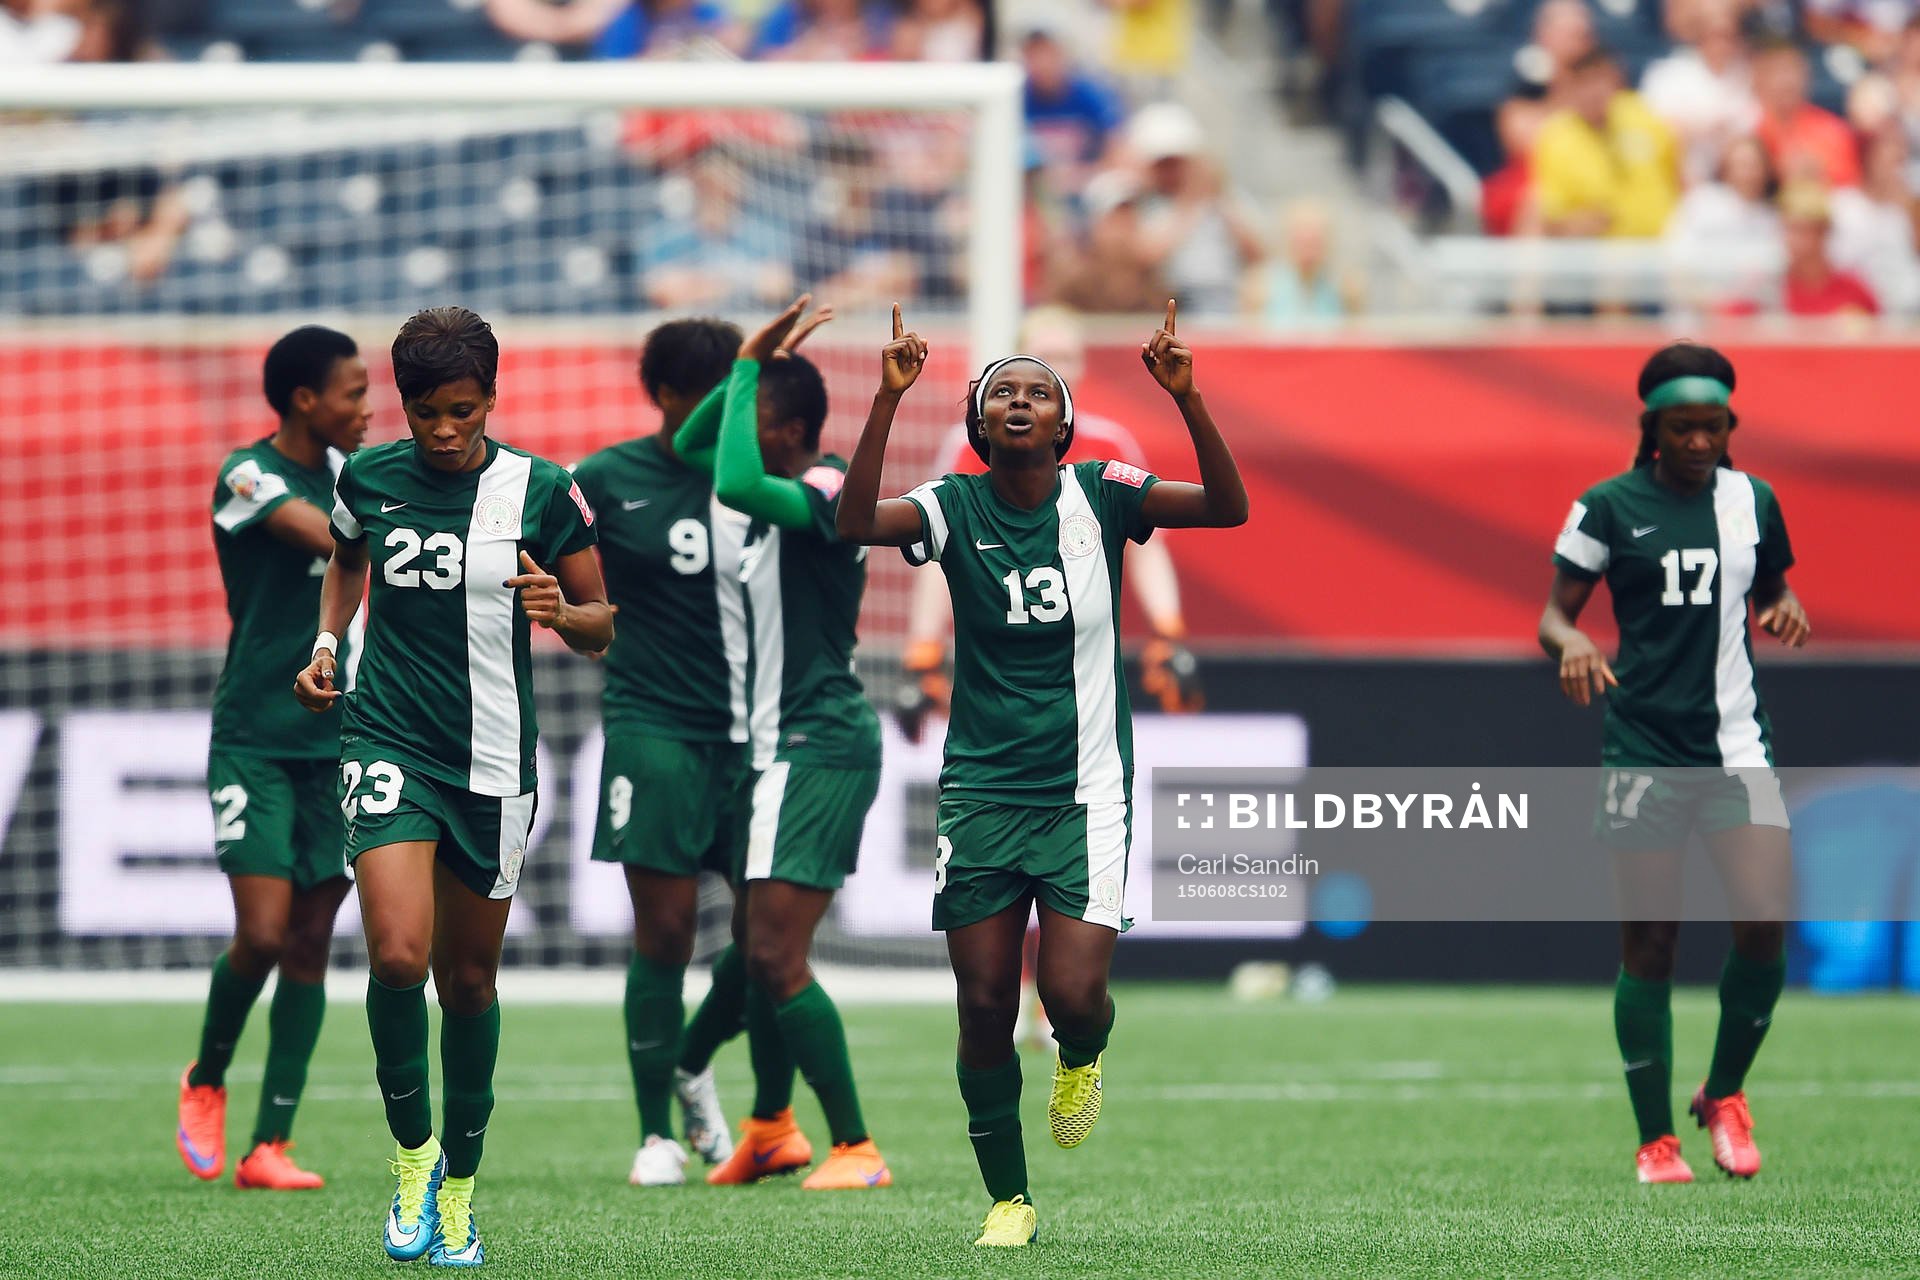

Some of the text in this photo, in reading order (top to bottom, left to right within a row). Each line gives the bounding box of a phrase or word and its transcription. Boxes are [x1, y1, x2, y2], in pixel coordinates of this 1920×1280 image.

[383, 527, 464, 590] 23
[668, 518, 710, 575] 9
[1002, 566, 1069, 624] 13
[1660, 548, 1719, 606] 17
[340, 760, 405, 822] 23
[609, 775, 634, 831] 9
[1605, 771, 1654, 819] 17
